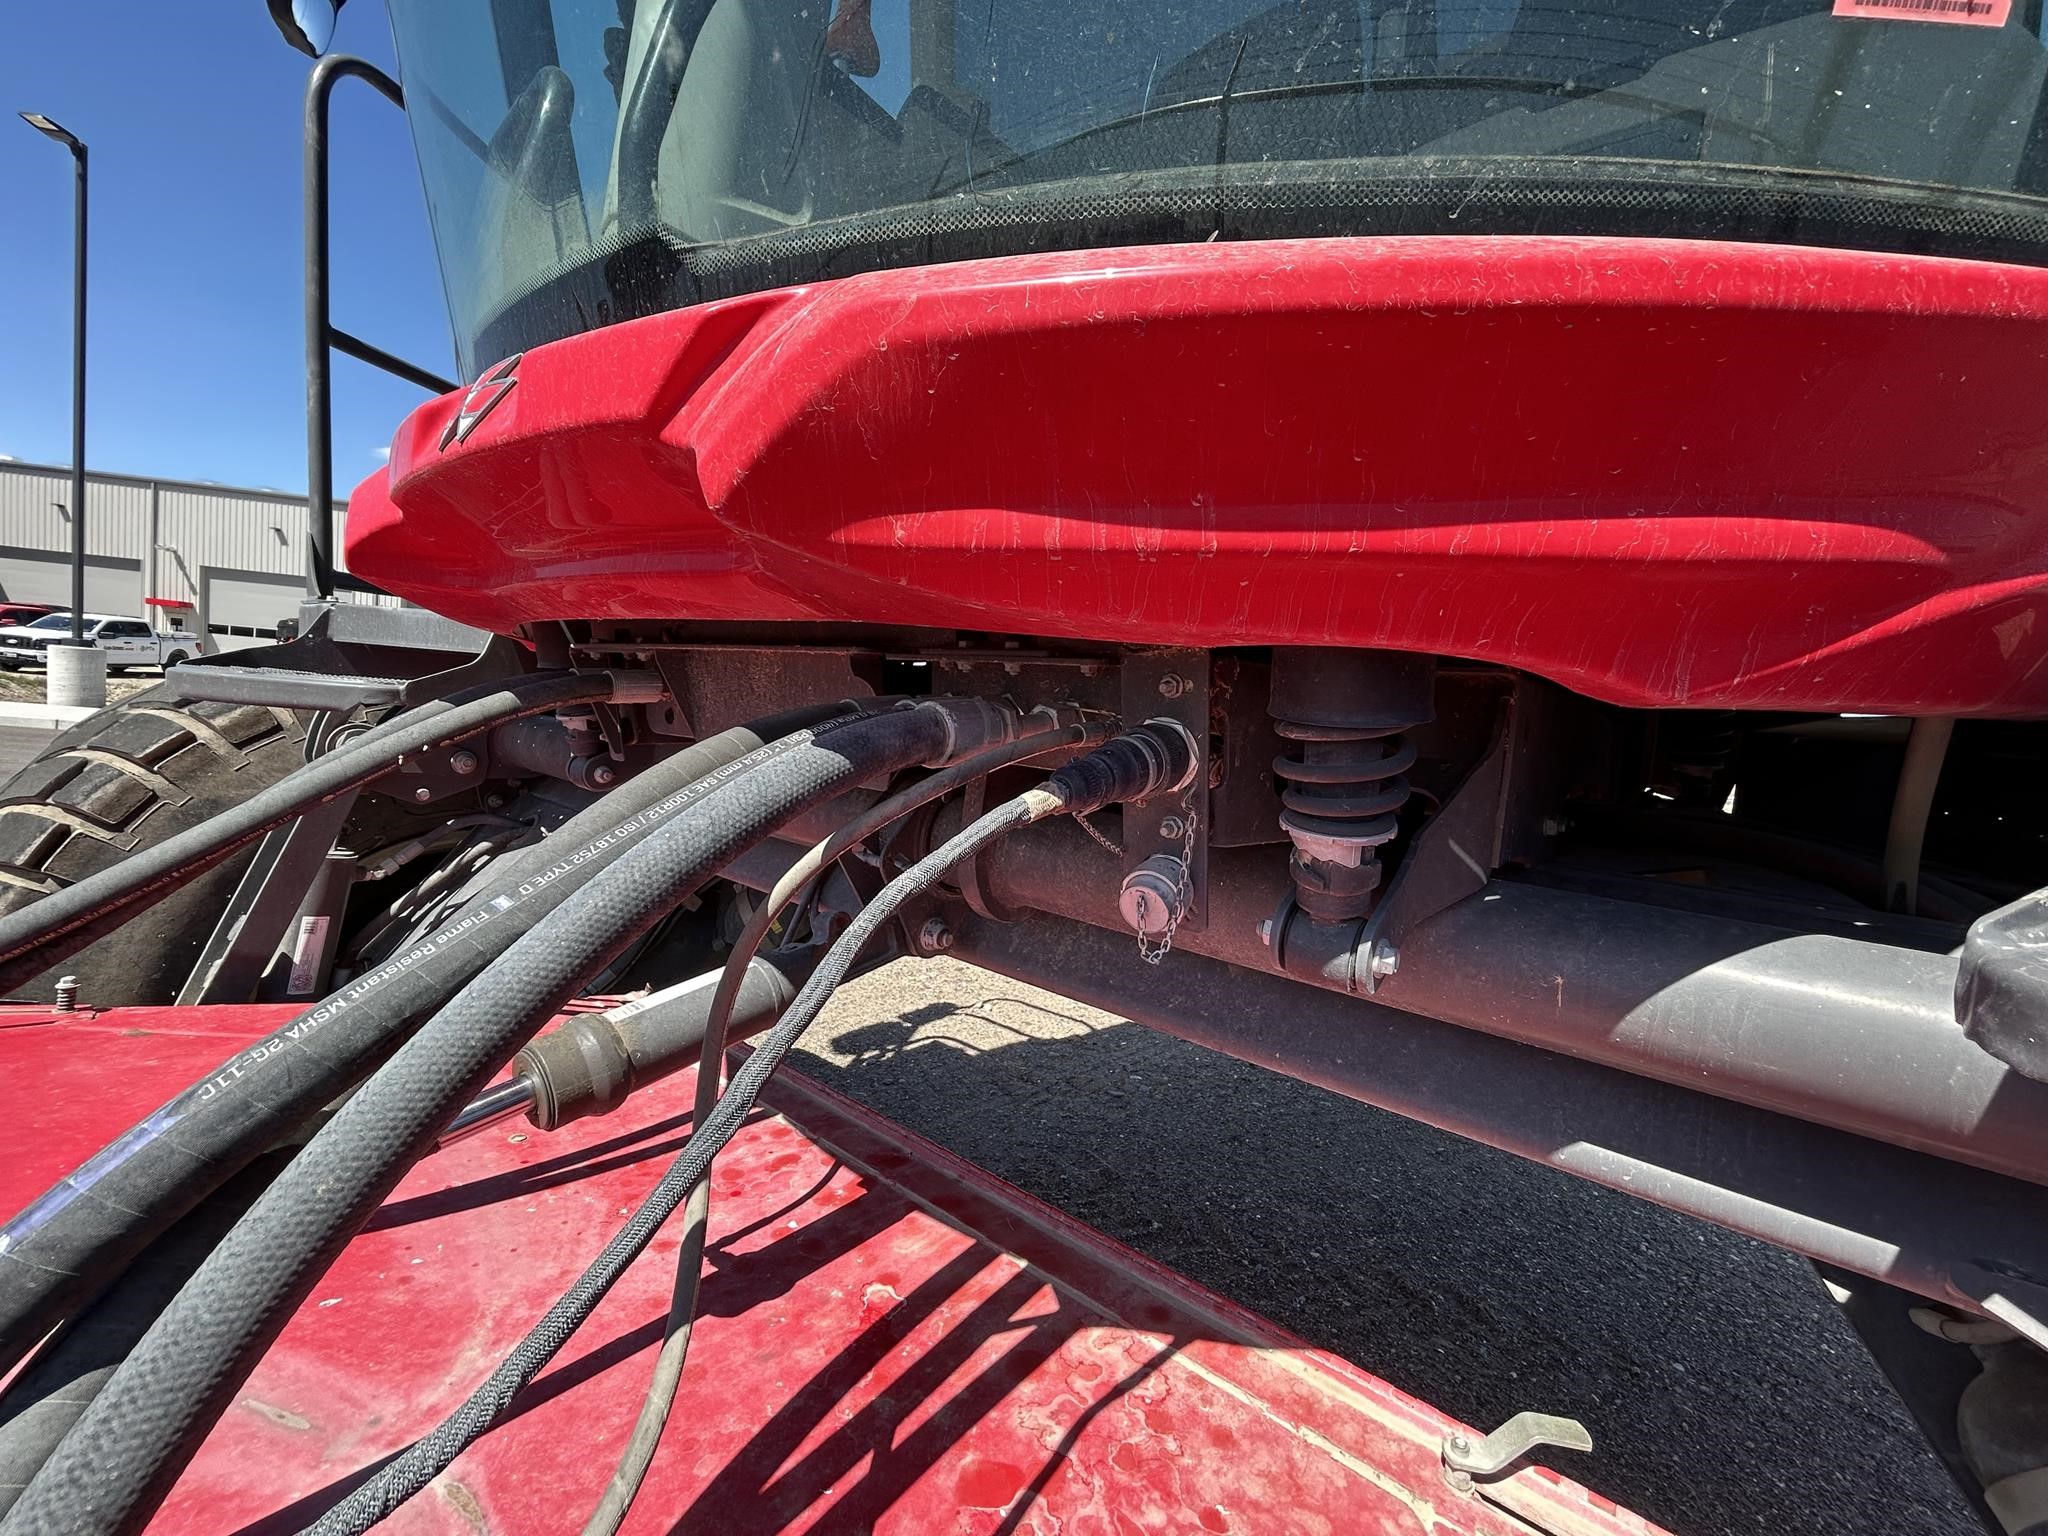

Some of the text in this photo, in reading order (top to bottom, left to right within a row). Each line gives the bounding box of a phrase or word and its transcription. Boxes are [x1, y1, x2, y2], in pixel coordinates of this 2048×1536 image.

[690, 775, 718, 793] SAE
[643, 789, 694, 820] 100R12
[612, 817, 641, 840] ISO
[568, 832, 616, 866] 18752
[516, 881, 533, 896] D
[529, 857, 573, 889] TYPE
[433, 907, 490, 948] Flame
[345, 940, 436, 1003] Resistant
[282, 996, 346, 1044] MSHA
[195, 1035, 285, 1102] 2G-11C
